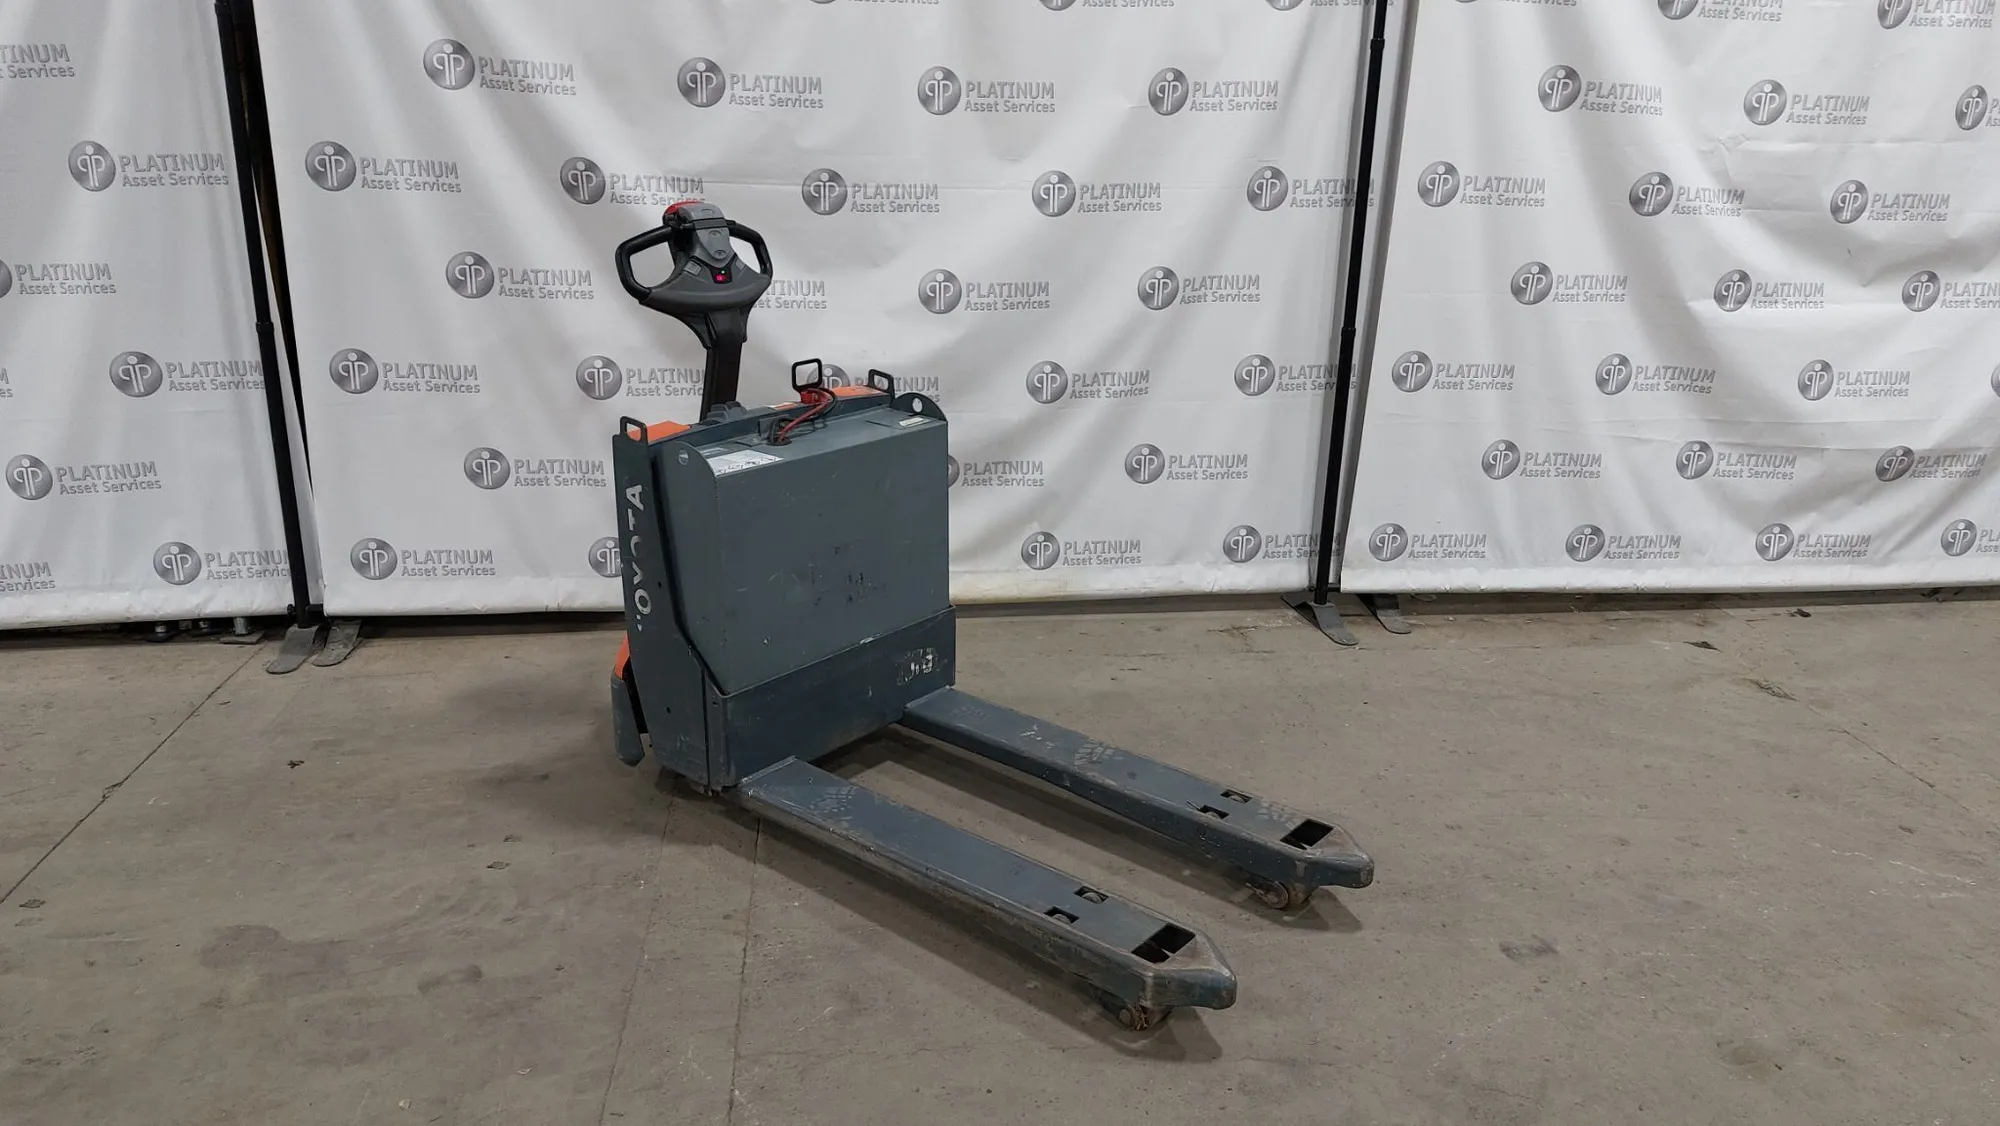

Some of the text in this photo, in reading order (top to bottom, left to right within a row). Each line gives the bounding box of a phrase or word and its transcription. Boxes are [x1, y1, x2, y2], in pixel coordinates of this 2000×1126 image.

[1698, 7, 1781, 21] Asset Services
[1914, 0, 1995, 15] PLATINUM
[1909, 15, 1993, 28] Asset Services
[0, 44, 70, 63] TINUM
[7, 64, 75, 78] Services
[478, 56, 574, 81] PLATINUM
[479, 77, 576, 96] Asset Services
[730, 74, 822, 94] PLATINUM
[965, 80, 1055, 100] PLATINUM
[1192, 81, 1278, 98] PLATINUM
[1584, 81, 1662, 103] PLATINUM
[729, 94, 823, 109] Asset Services
[964, 100, 1055, 113] Asset Services
[1189, 99, 1278, 111] Asset Services
[1579, 100, 1663, 116] Asset Services
[1790, 94, 1870, 111] PLATINUM
[1786, 112, 1867, 125] Asset Services
[118, 153, 225, 173] PLATINUM
[360, 157, 458, 180] PLATINUM
[122, 172, 229, 187] Asset Services
[361, 178, 462, 193] Asset Services
[610, 173, 704, 194] PLATINUM
[1292, 179, 1374, 194] PLATIN
[1463, 176, 1545, 194] PLATINUM
[610, 191, 647, 205] Asset
[851, 184, 938, 200] PLATINUM
[1079, 183, 1161, 200] PLATINUM
[1677, 187, 1745, 205] PLATINUM
[850, 200, 940, 213] Asset Services
[1077, 200, 1161, 213] Asset Services
[1290, 196, 1322, 208] Asset
[1460, 193, 1545, 207] Asset Services
[1871, 193, 1950, 210] PLATINUM
[1672, 203, 1741, 217] Asset Services
[1867, 210, 1948, 222] Asset Services
[15, 263, 112, 281] PLATINUM
[498, 267, 592, 286] PLATINUM
[19, 281, 116, 295] Asset Services
[767, 280, 825, 296] TINUM
[965, 281, 1049, 299] PLATINUM
[1182, 274, 1260, 293] PLATINUM
[1556, 274, 1627, 291] PLATINUM
[1754, 282, 1824, 298] PLATINUM
[1943, 283, 2000, 297] PLATIN
[498, 286, 594, 300] Asset Services
[1180, 291, 1260, 305] Asset Services
[1553, 291, 1625, 302] Asset Services
[775, 297, 827, 309] Services
[964, 298, 1050, 311] Asset Services
[1751, 298, 1824, 309] Asset Services
[1940, 298, 1971, 309] Asset
[165, 361, 263, 378] PLATINUM
[381, 363, 478, 381] PLATINUM
[626, 368, 705, 383] PLATINU
[1279, 364, 1356, 380] PLATIN
[1436, 363, 1515, 379] PLATINUM
[1634, 366, 1715, 383] PLATINUM
[169, 380, 207, 391] Asset
[1070, 370, 1150, 388] PLATINUM
[1432, 379, 1513, 391] Asset Services
[1836, 371, 1910, 385] PLATINUM
[382, 380, 480, 393] Asset Services
[626, 385, 704, 396] Asset Servic
[1069, 384, 1150, 399] Asset Services
[1276, 381, 1307, 392] Asset
[1632, 381, 1712, 394] Asset Services
[1835, 386, 1909, 397] Asset Services
[513, 459, 604, 475] PLATINUM
[1168, 454, 1248, 469] PLATINUM
[1523, 452, 1601, 467] PLATINUM
[1716, 452, 1796, 469] PLATINUM
[1914, 454, 1986, 468] PLATINUM
[54, 462, 157, 482] PLATINUM
[963, 460, 1043, 476] PLATINUM
[1167, 468, 1248, 480] Asset Services
[1519, 467, 1600, 479] Asset Services
[1712, 468, 1794, 480] Asset Services
[1908, 468, 1938, 478] Asset
[59, 479, 161, 495] Asset Services
[514, 475, 606, 487] Asset Services
[962, 475, 1044, 487] Asset Services
[1063, 540, 1141, 555] PLATINUM
[1411, 533, 1486, 548] PLATINUM
[1607, 535, 1681, 549] PLATINUM
[1796, 534, 1872, 548] PLATINUM
[1262, 549, 1292, 559] Asset
[1408, 548, 1486, 559] Asset Services
[1604, 549, 1679, 559] Asset Services
[1793, 548, 1867, 558] Asset Services
[1976, 544, 2000, 553] Asse
[204, 551, 287, 567] PLATINU
[401, 549, 493, 565] PLATINUM
[1062, 553, 1141, 566] Asset Services
[0, 562, 51, 579] INUM
[207, 569, 243, 579] Asset
[401, 565, 496, 576] Asset Services
